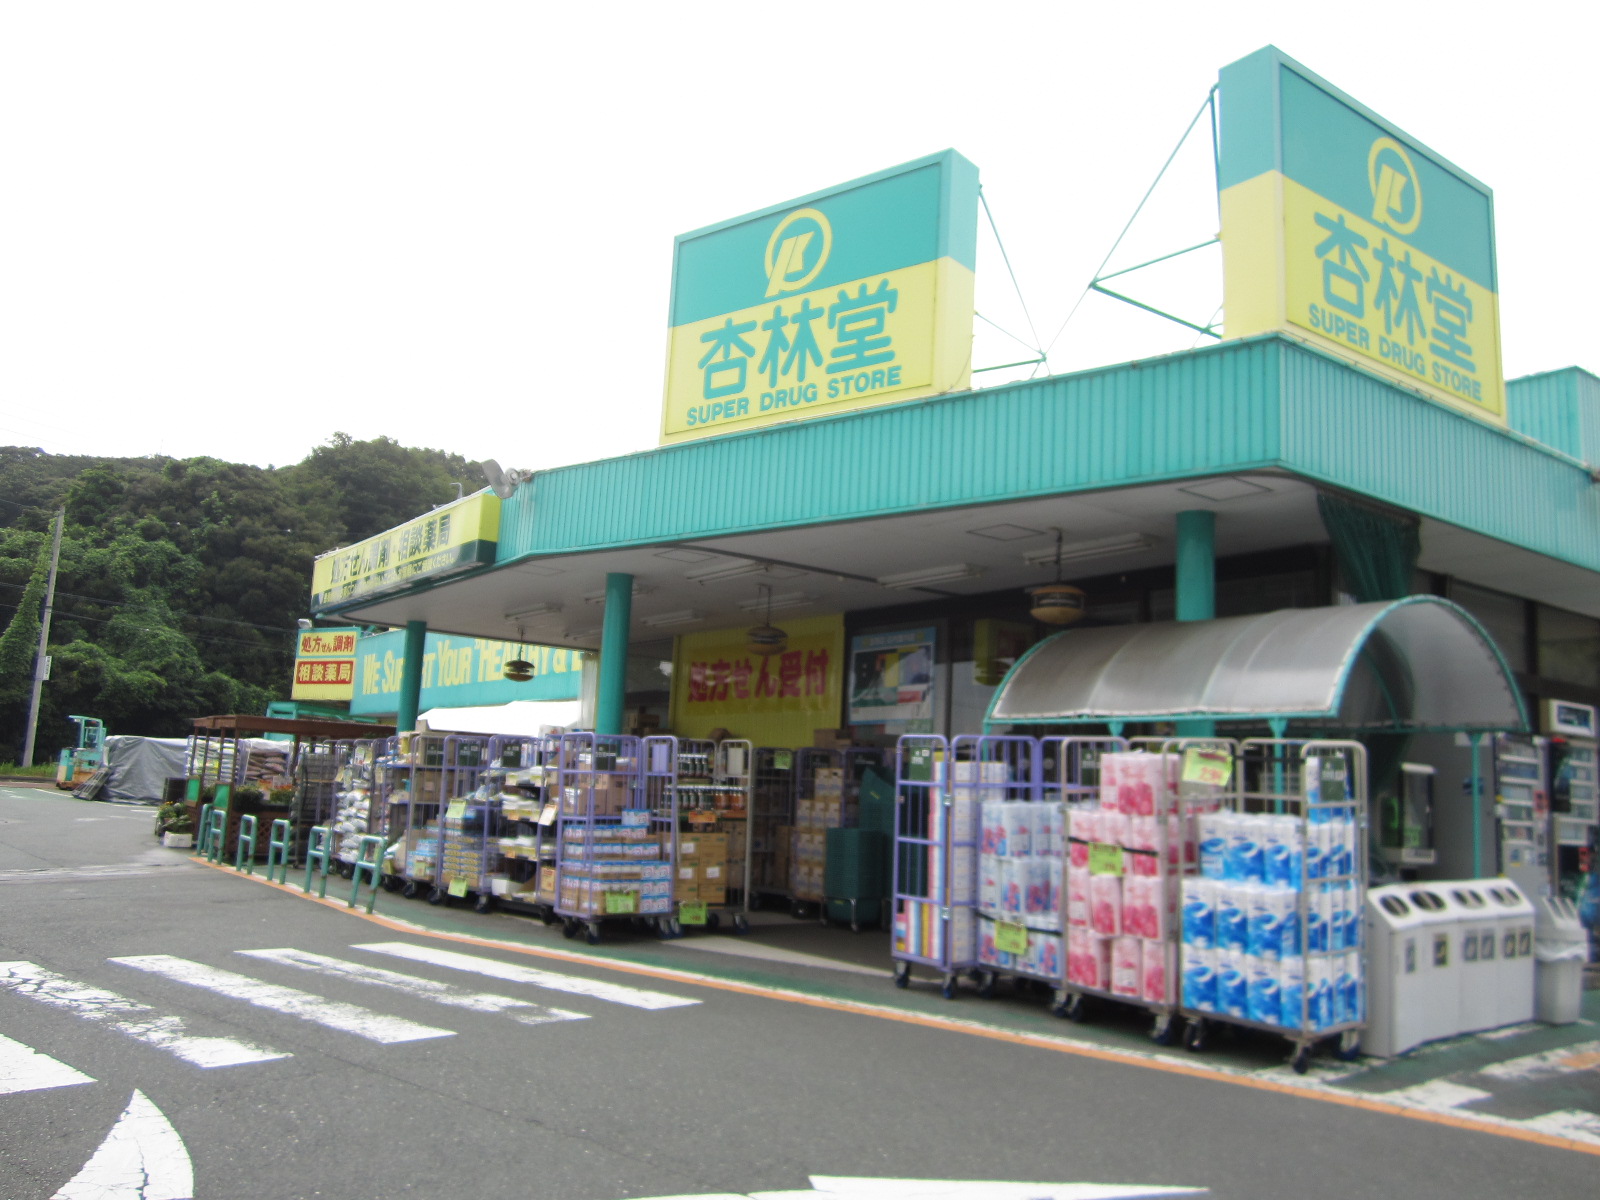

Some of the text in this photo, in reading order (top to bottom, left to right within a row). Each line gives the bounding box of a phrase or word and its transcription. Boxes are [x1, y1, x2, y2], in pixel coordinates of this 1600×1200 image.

[1313, 211, 1476, 374] 杏林堂
[697, 278, 899, 400] 杏林堂
[1308, 303, 1482, 401] SUPER DRUG STORE
[686, 365, 902, 426] SUPER DRUG STORE
[298, 663, 352, 682] 相談薬局
[301, 634, 354, 652] 処方せん調剤
